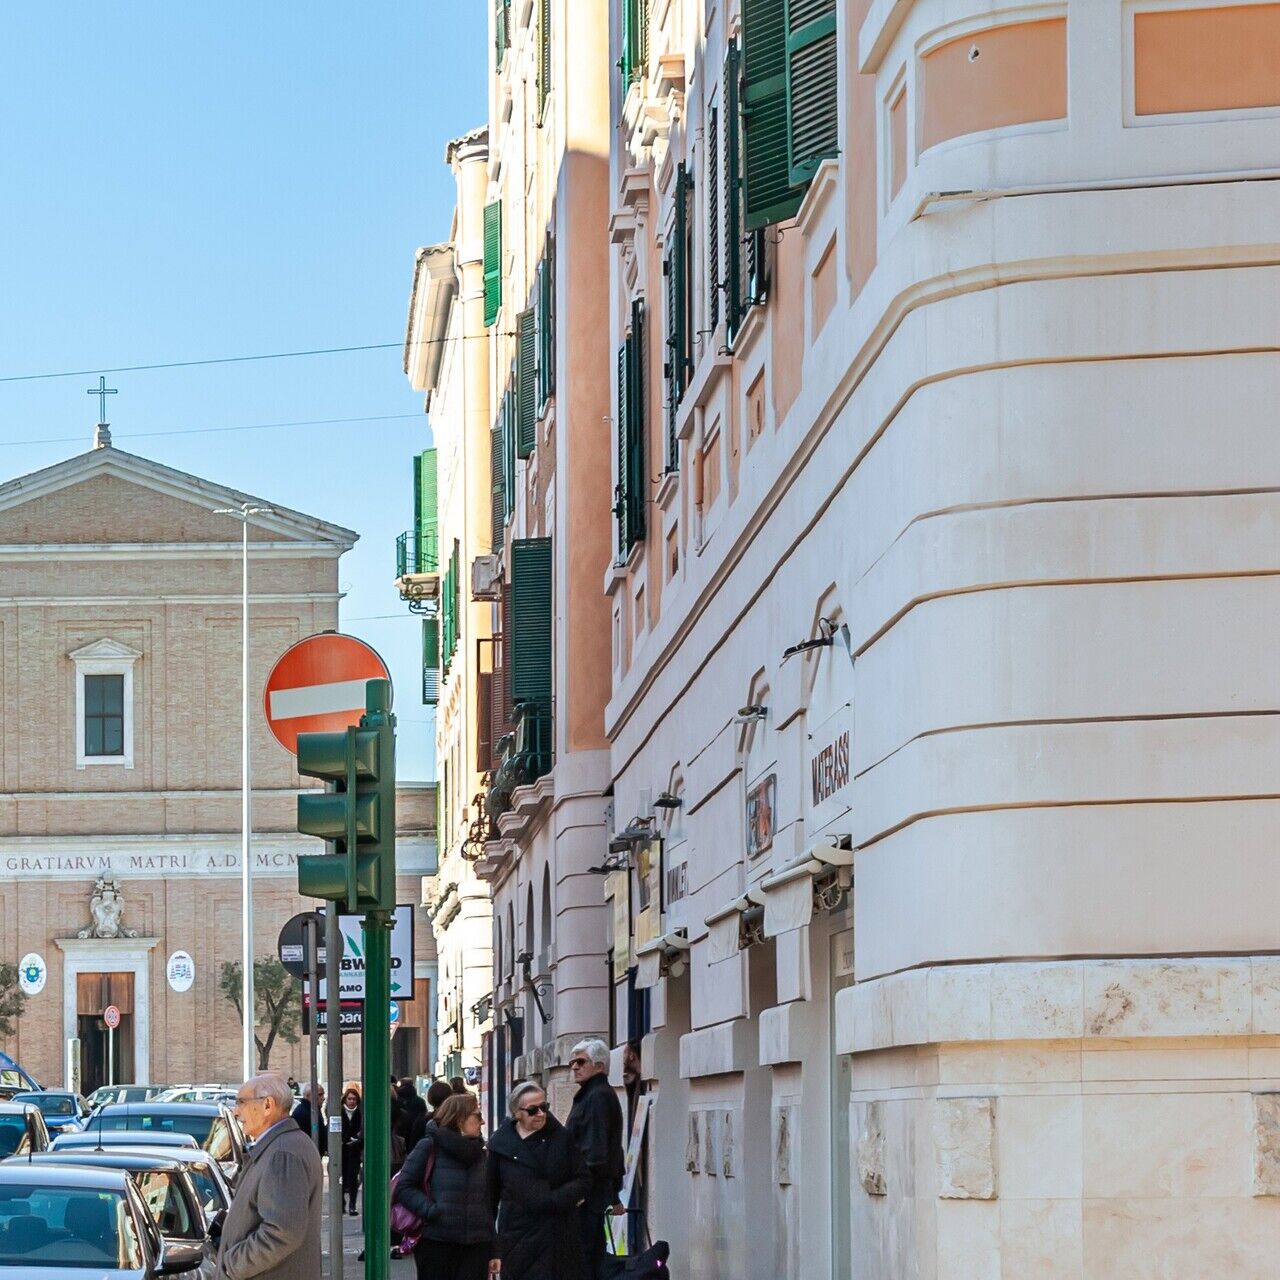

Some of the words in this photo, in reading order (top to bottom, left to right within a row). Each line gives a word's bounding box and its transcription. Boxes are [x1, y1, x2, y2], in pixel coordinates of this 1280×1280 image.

[812, 730, 850, 807] MATERASSI
[6, 856, 112, 871] GRATIARVM
[129, 855, 187, 869] MATRI
